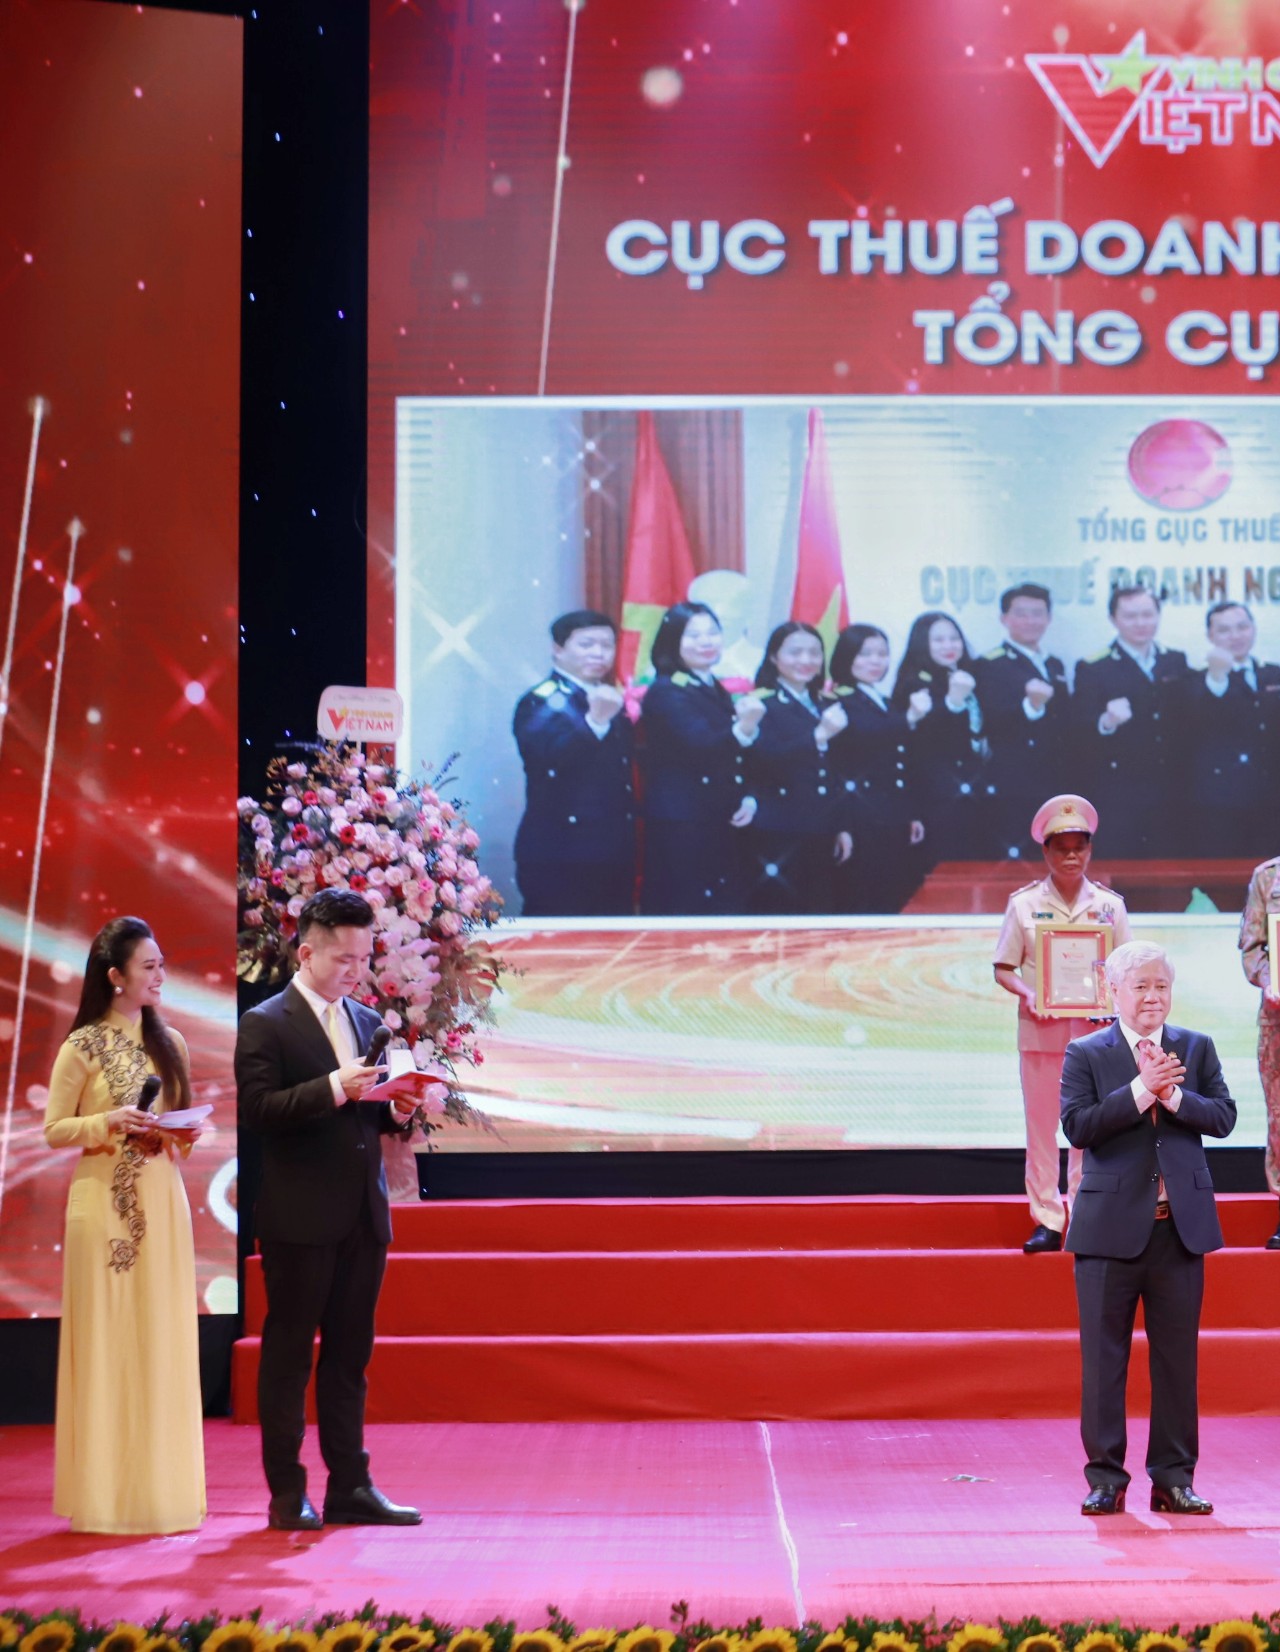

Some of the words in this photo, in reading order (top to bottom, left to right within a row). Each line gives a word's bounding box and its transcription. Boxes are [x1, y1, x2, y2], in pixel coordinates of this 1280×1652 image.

[1172, 56, 1264, 92] VINH
[605, 219, 786, 290] CỤC
[808, 197, 1014, 274] THUẾ
[913, 281, 1142, 366] TỔNG
[1156, 517, 1208, 547] CỤC
[920, 564, 997, 612] CỤC
